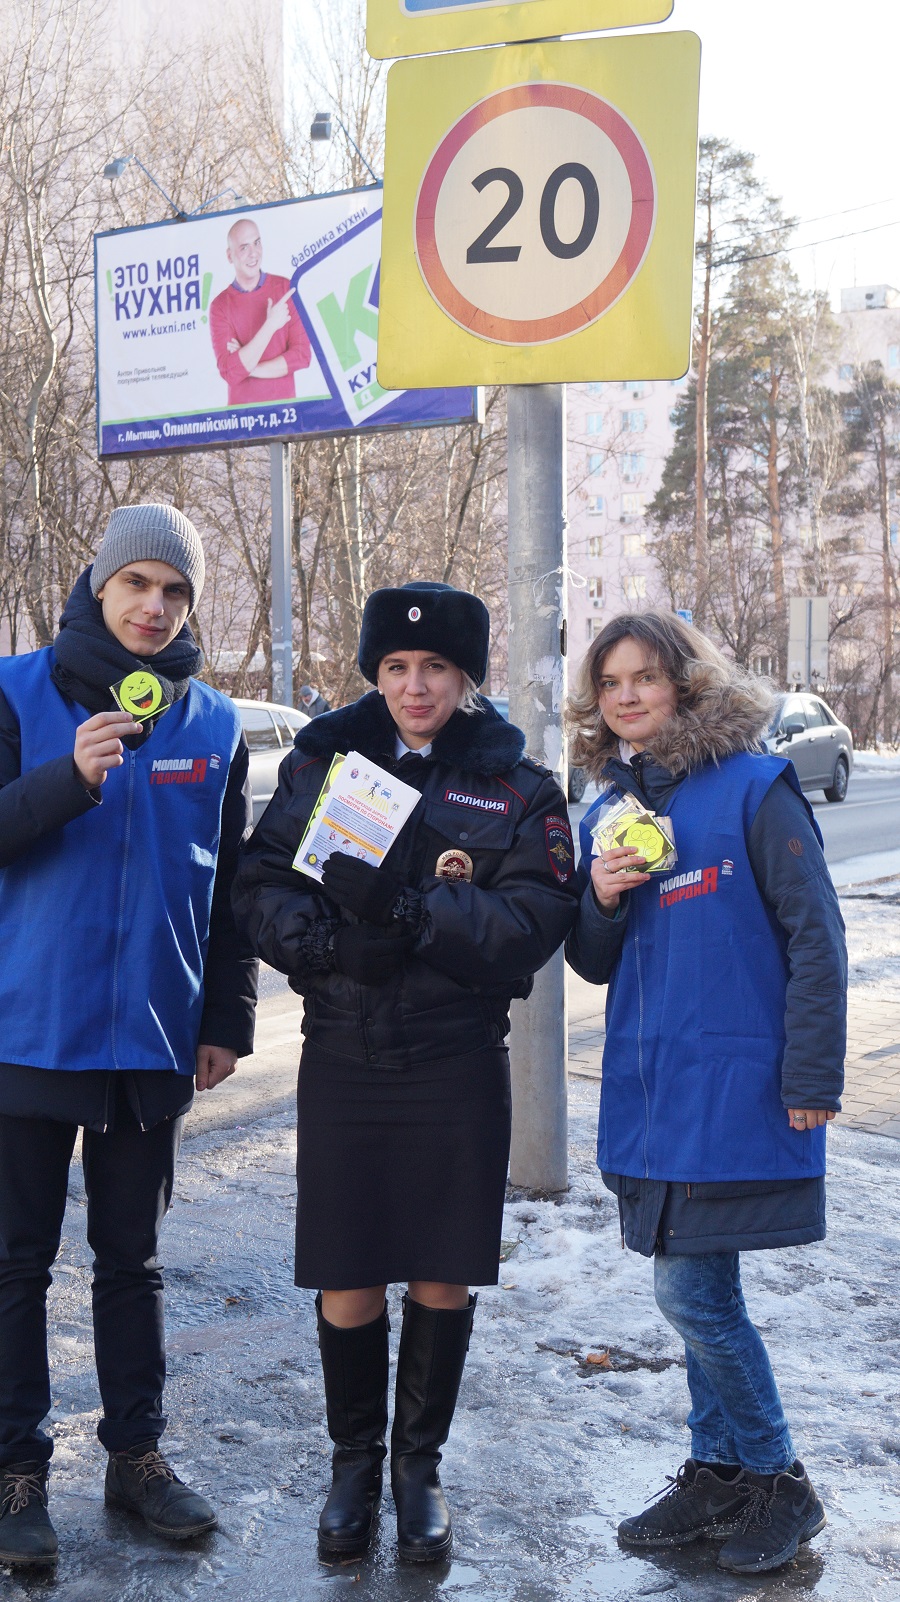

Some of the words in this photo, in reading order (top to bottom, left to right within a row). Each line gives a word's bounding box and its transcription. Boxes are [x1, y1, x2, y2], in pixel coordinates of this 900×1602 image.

[466, 162, 600, 264] 20
[291, 231, 335, 267] фабрика
[336, 207, 368, 232] кухни
[157, 254, 199, 282] МОЯ
[122, 320, 196, 339] www.kuxni.net
[118, 434, 124, 442] г.
[126, 430, 162, 441] Мытищи,
[163, 414, 239, 437] Олимпийский
[240, 413, 268, 431] пр-т,
[269, 412, 281, 427] д.
[282, 408, 297, 423] 23
[447, 792, 506, 811] ПОЛИЦИЯ
